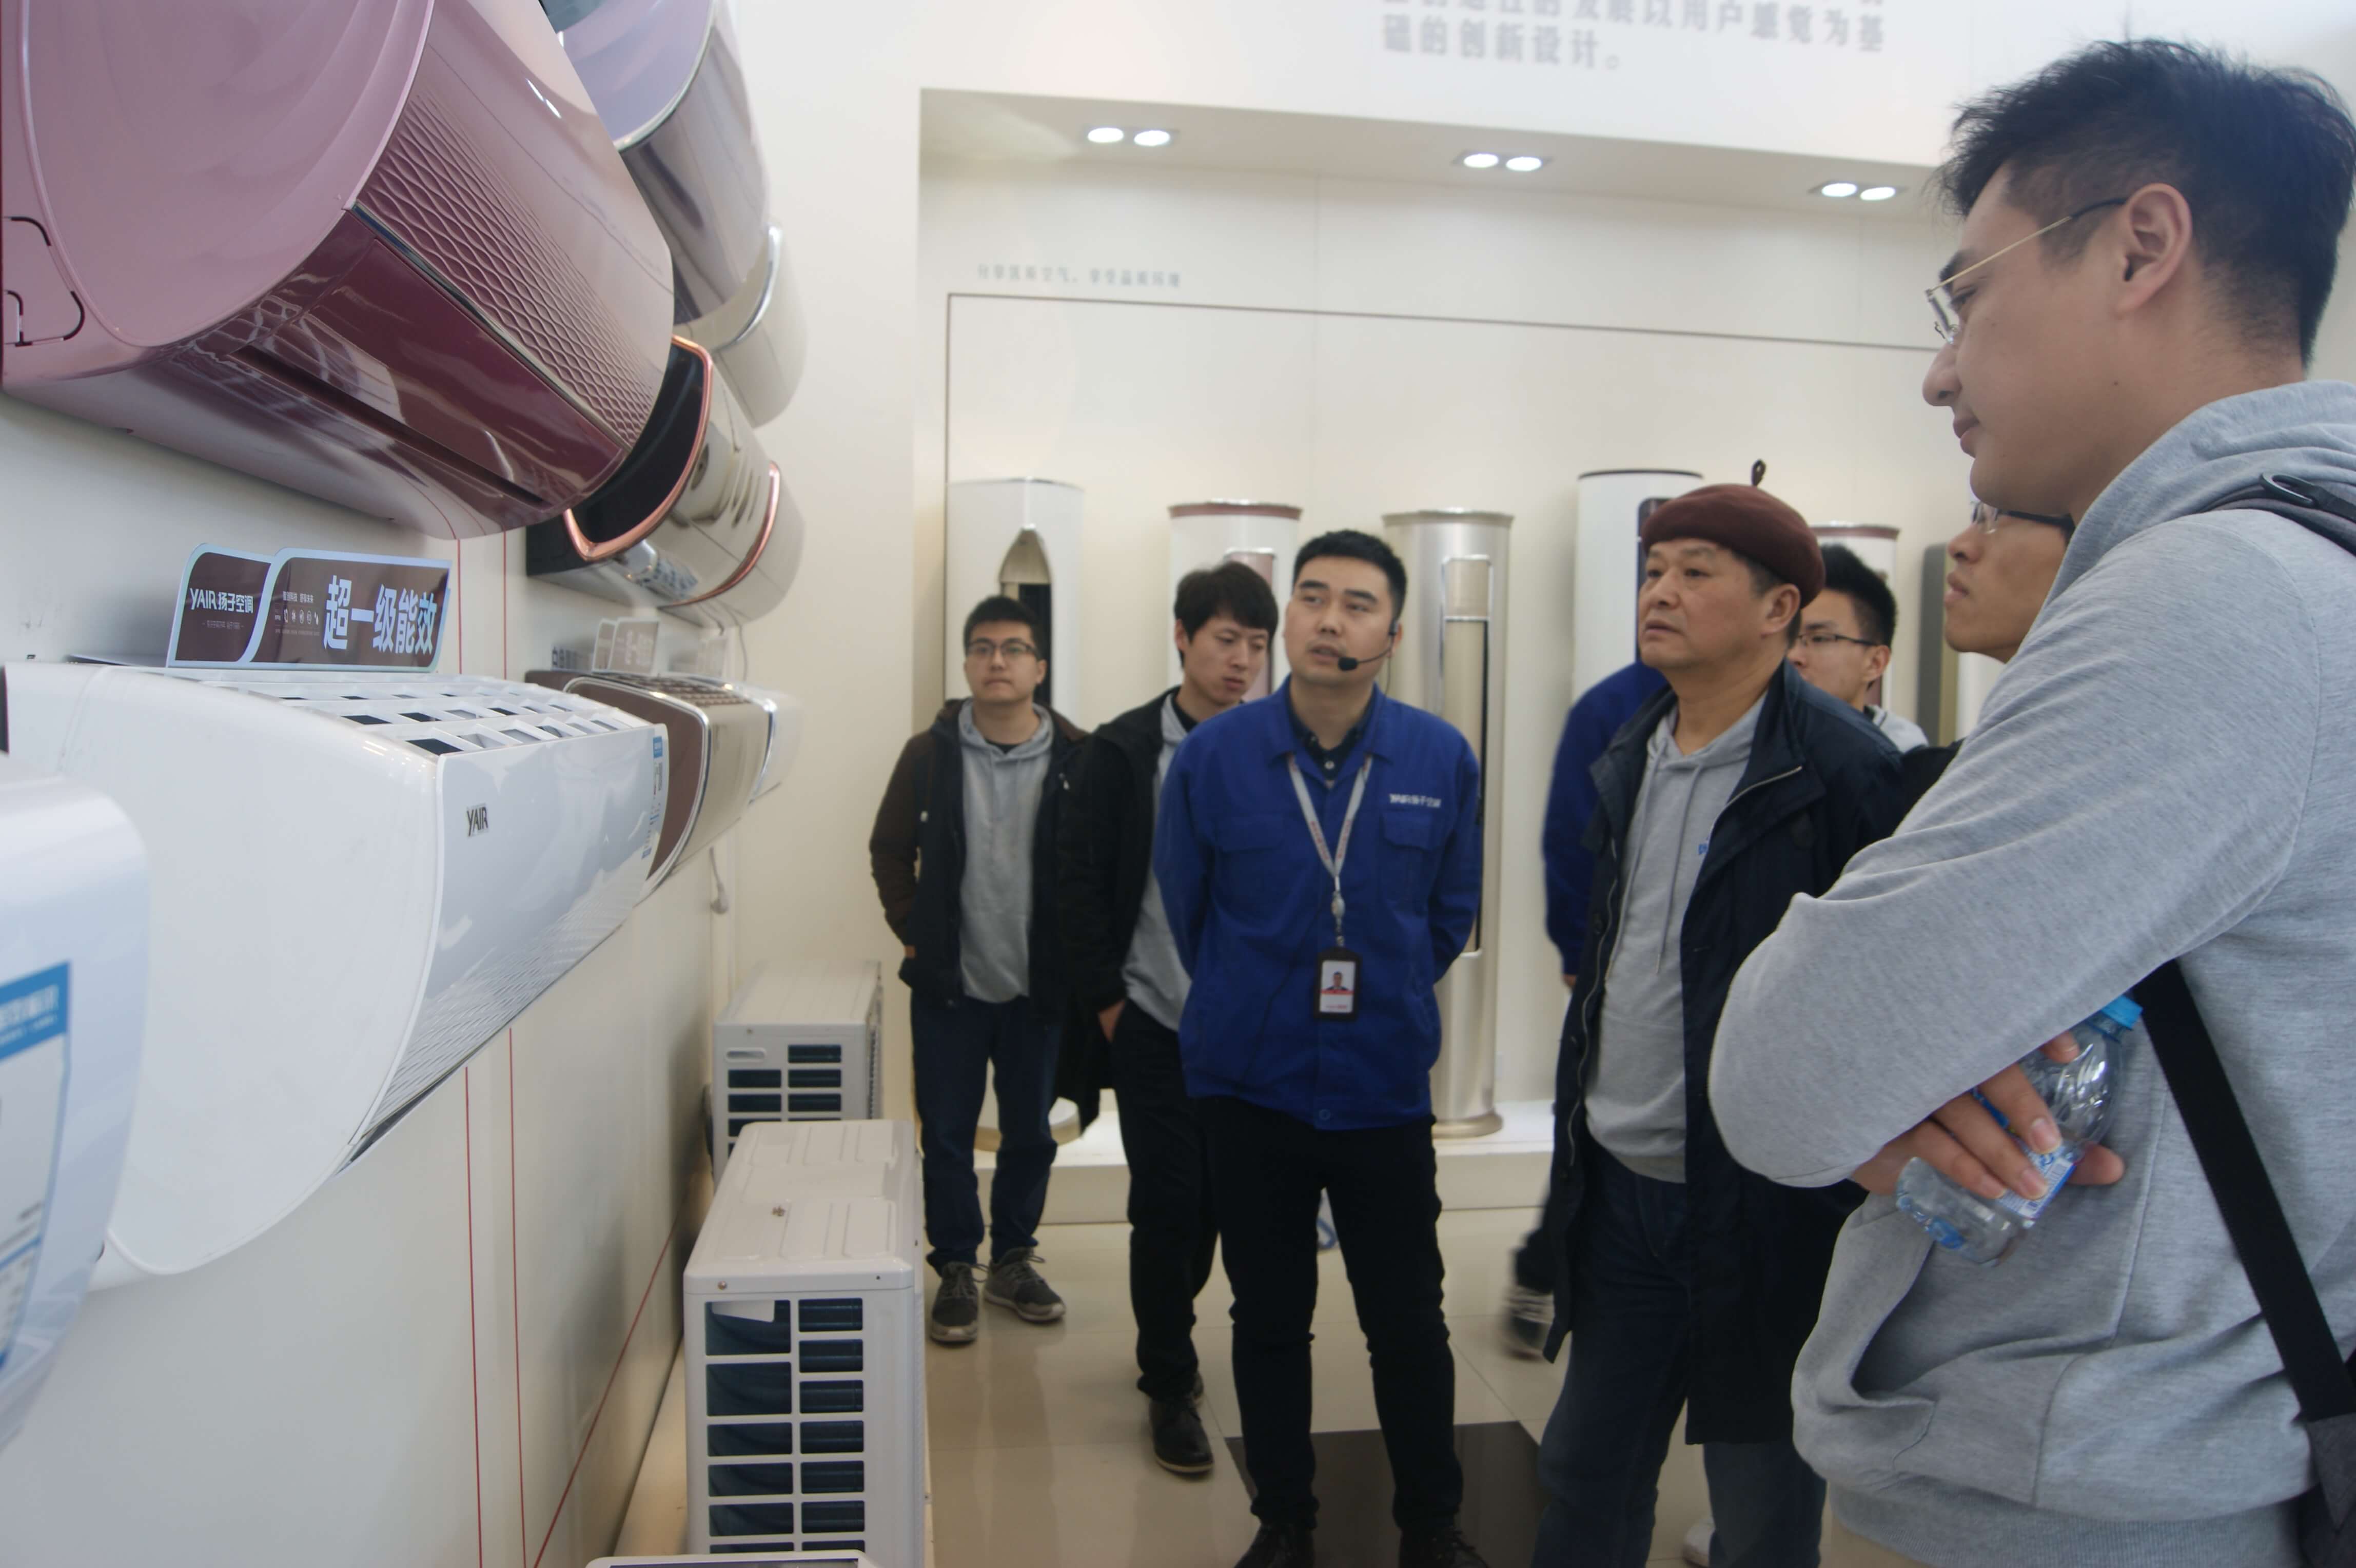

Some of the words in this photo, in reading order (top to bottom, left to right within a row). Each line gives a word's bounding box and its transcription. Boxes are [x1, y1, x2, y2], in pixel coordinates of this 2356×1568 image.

[189, 588, 217, 610] YAIR
[218, 592, 253, 614] 扬子空调
[323, 575, 438, 655] 超一级能效
[466, 807, 488, 837] YAIR
